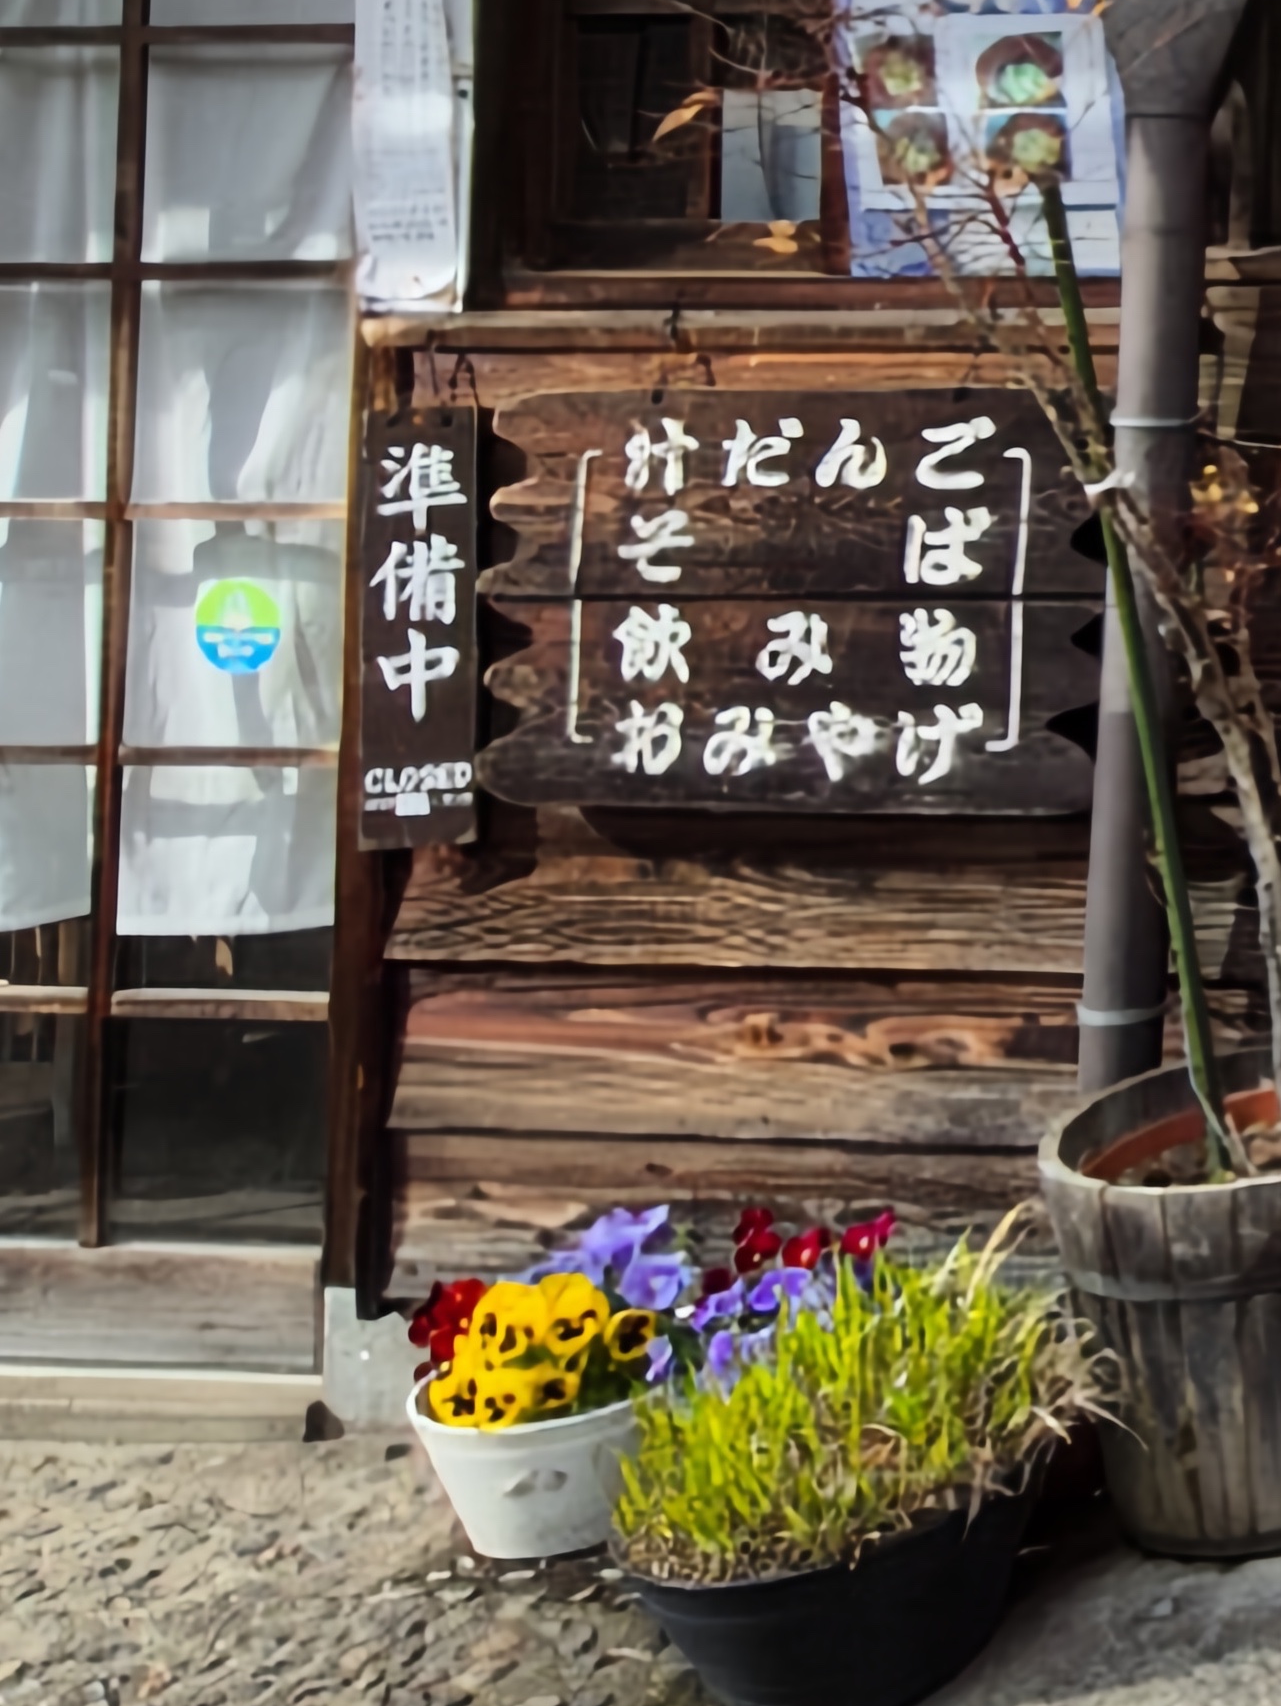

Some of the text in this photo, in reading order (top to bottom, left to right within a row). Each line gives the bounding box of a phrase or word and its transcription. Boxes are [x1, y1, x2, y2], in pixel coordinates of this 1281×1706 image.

[369, 444, 467, 724] 準備中
[617, 507, 992, 586] そば
[612, 603, 977, 687] 飲み物
[364, 761, 473, 794] CLOSED
[611, 699, 984, 786] おみやげ
